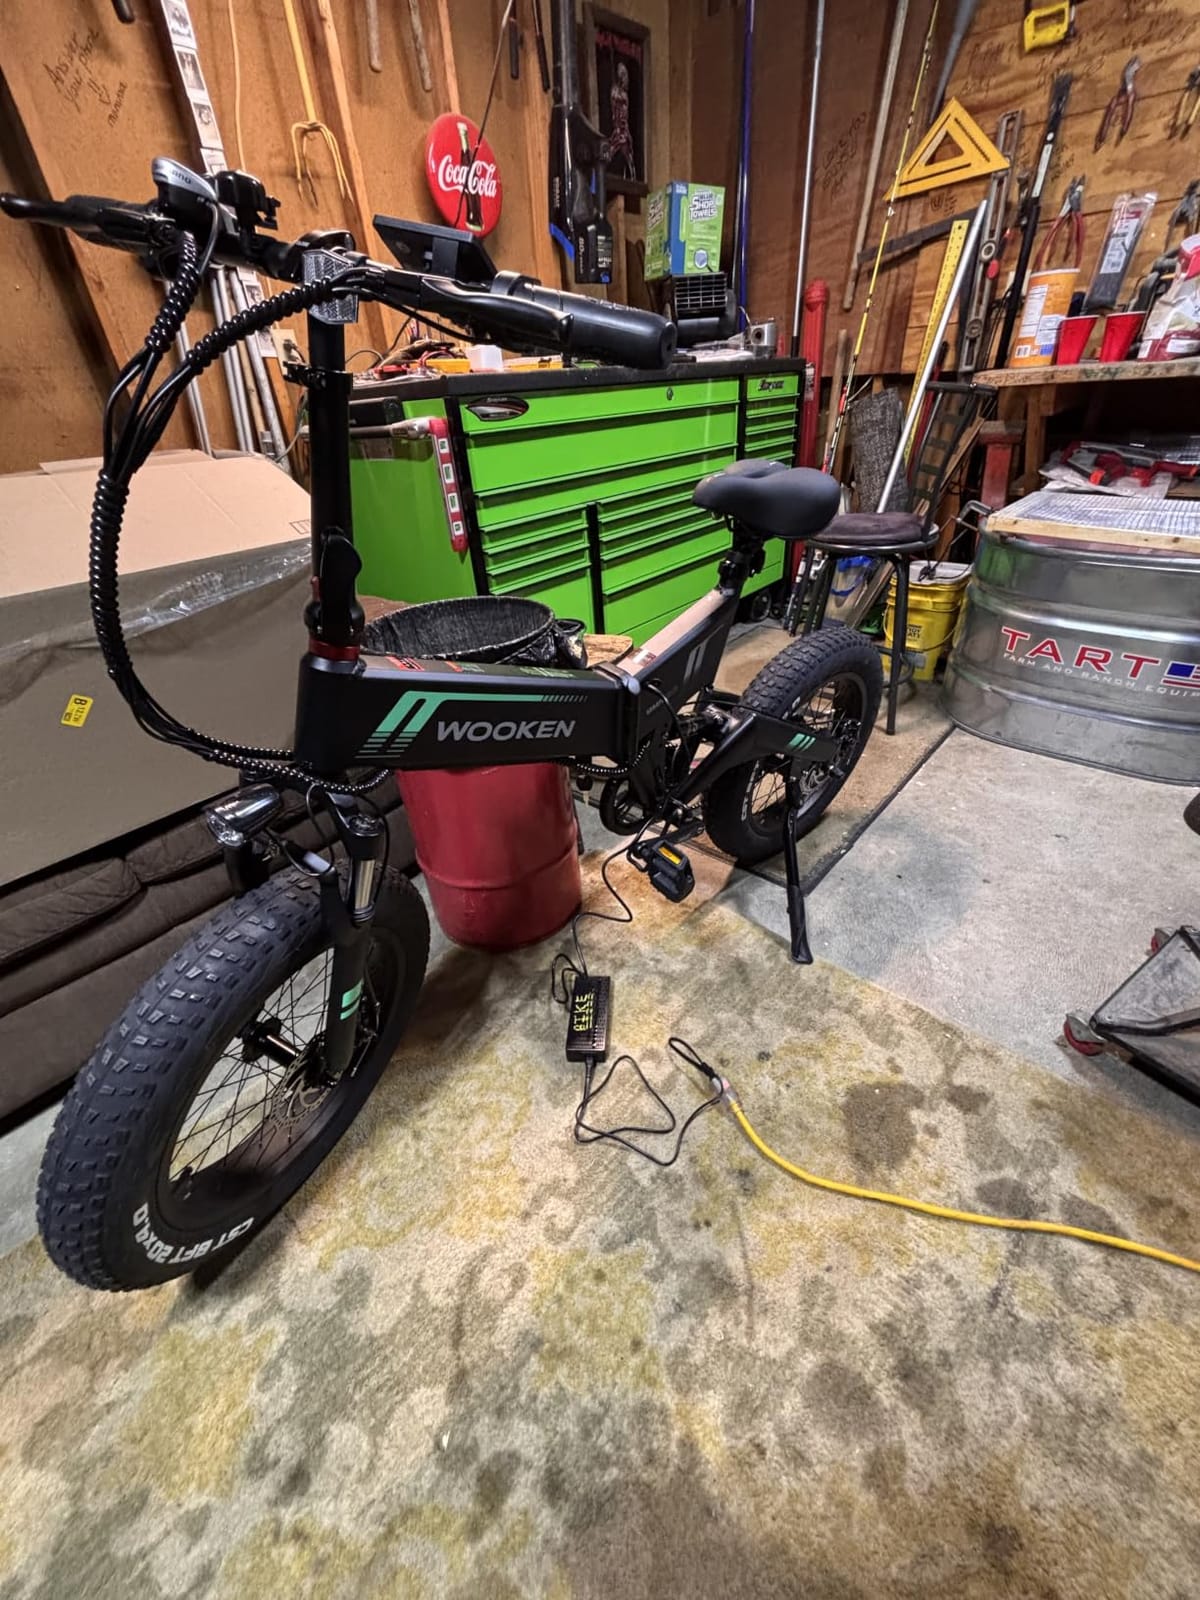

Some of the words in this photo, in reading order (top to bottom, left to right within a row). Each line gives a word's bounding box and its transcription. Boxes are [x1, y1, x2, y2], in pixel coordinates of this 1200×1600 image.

[1002, 653, 1036, 667] FARM
[1044, 664, 1073, 675] AND
[1080, 672, 1136, 688] RANCH
[74, 697, 88, 706] B
[437, 720, 576, 742] WOOKEN
[573, 994, 590, 1032] BIKE
[211, 1216, 254, 1252] CST
